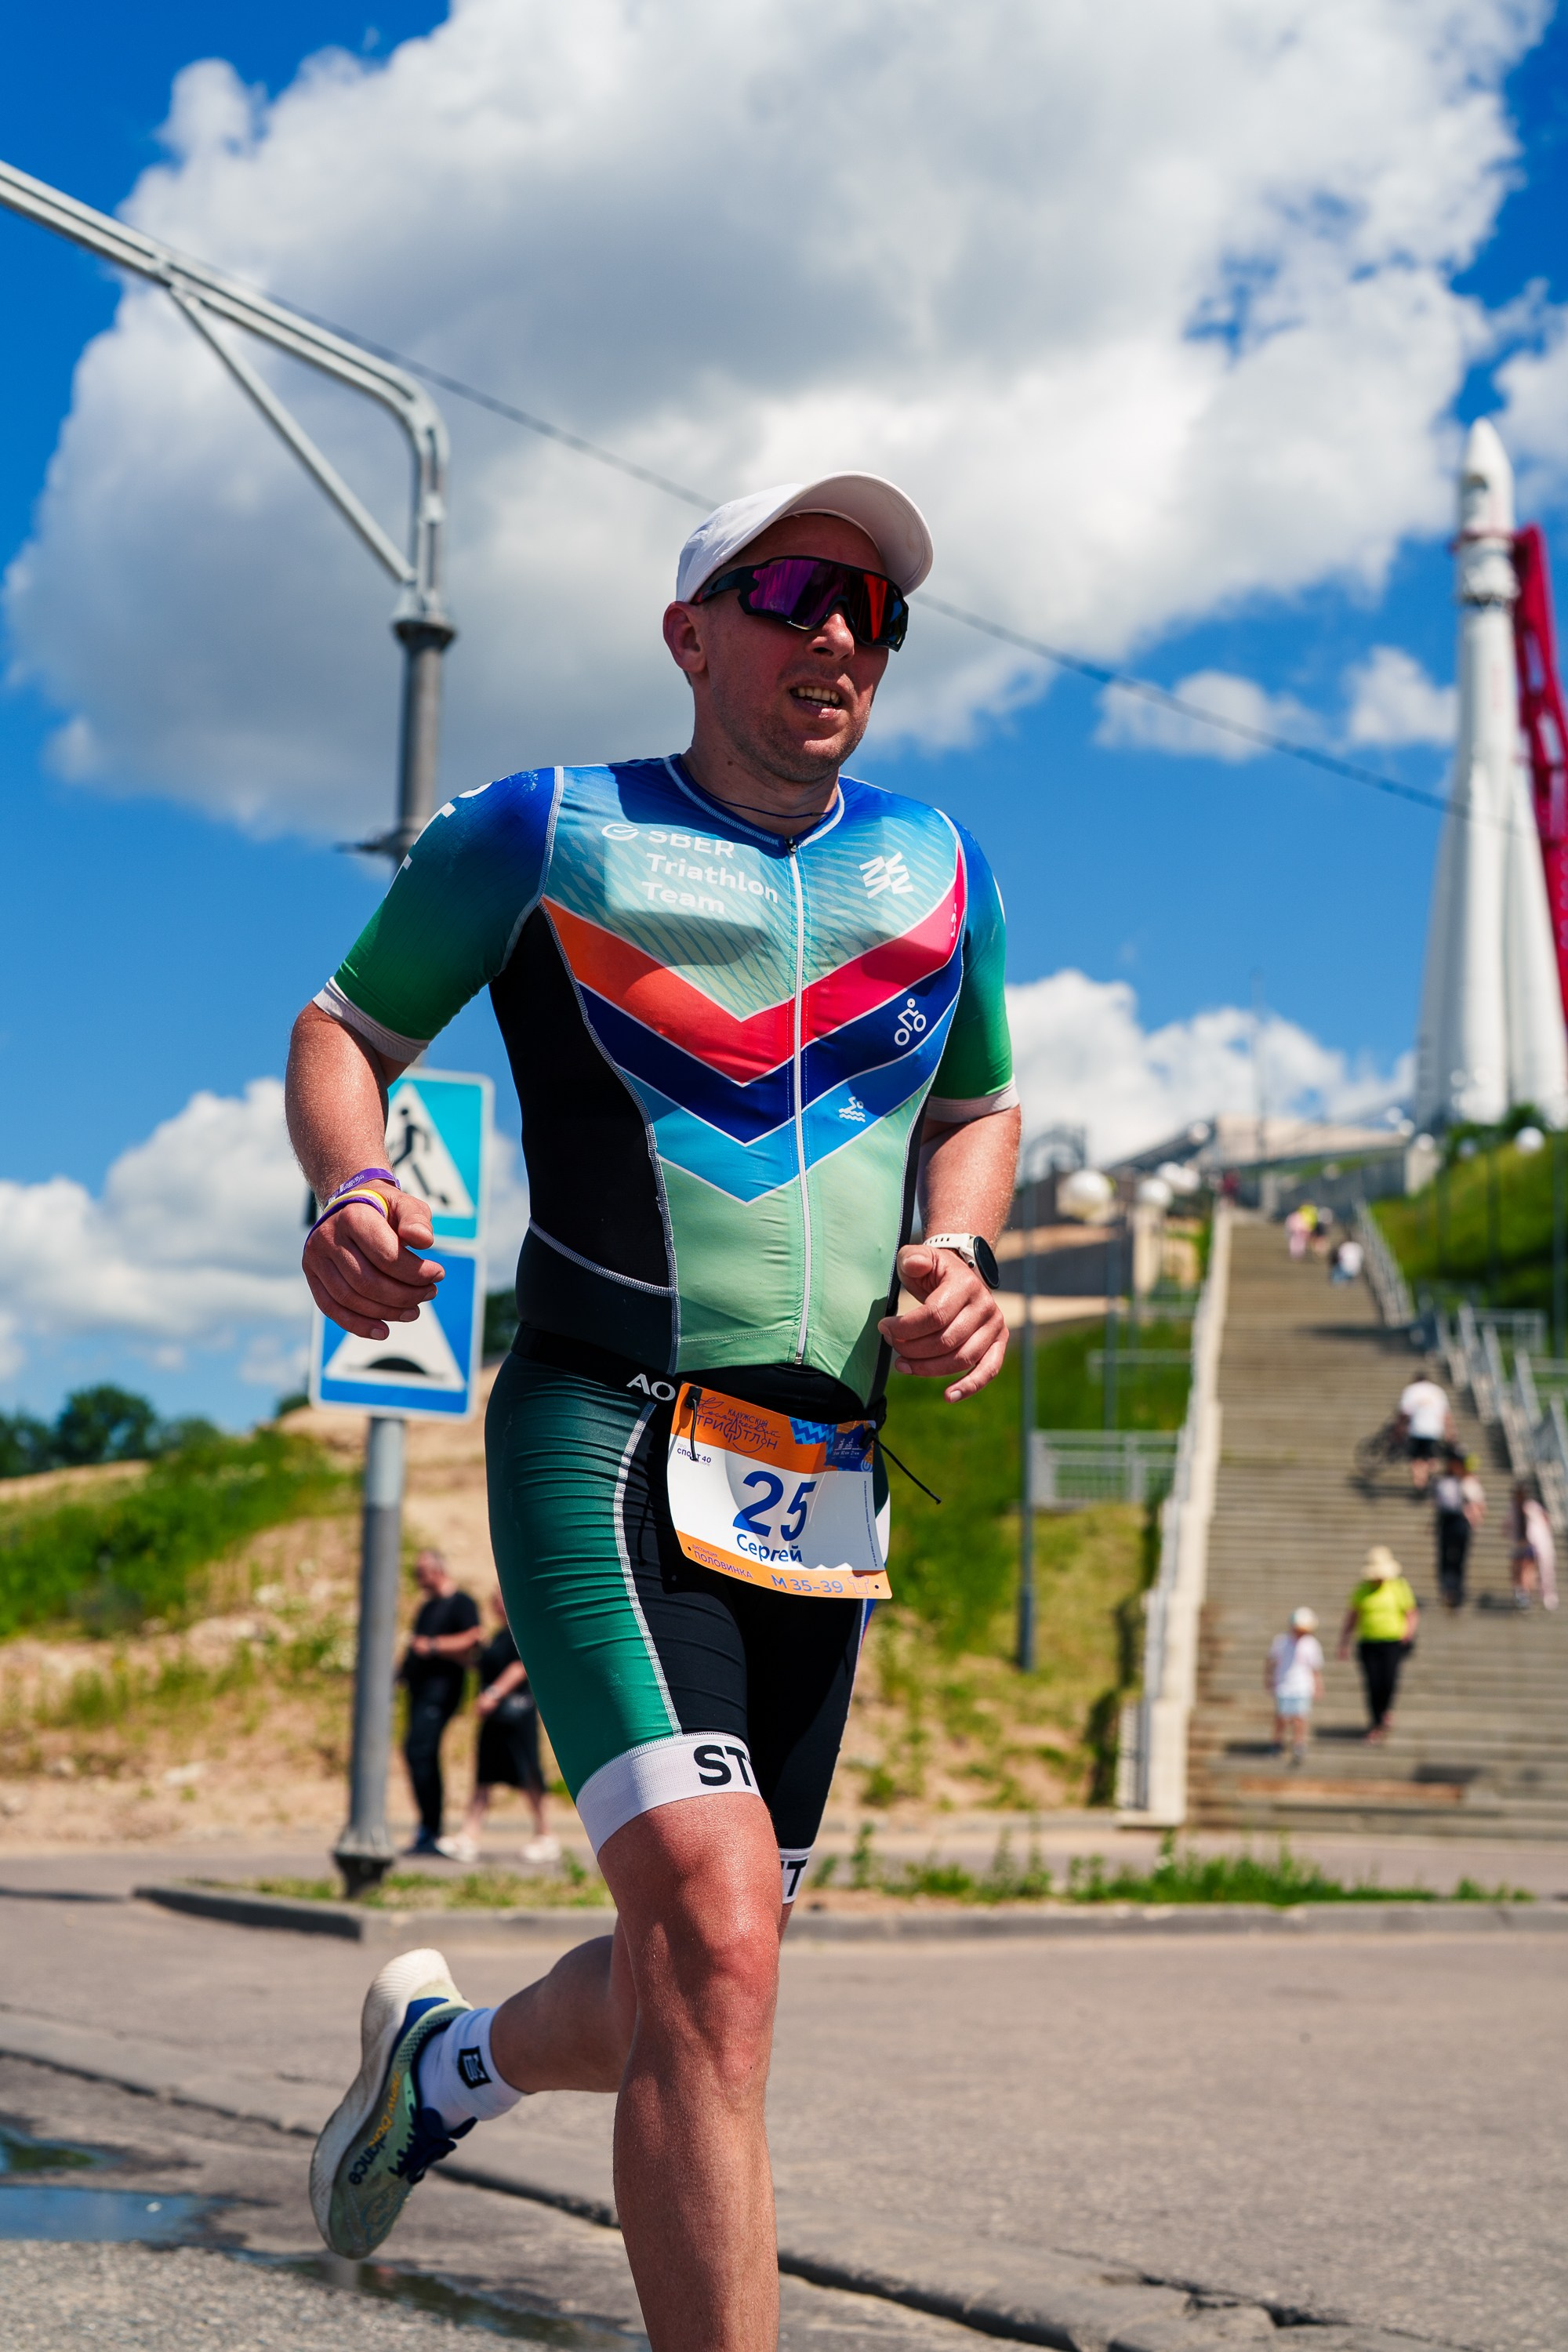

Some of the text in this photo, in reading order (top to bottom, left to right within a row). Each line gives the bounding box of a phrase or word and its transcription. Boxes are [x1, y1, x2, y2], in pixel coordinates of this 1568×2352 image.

[648, 830, 735, 859] SBER
[646, 852, 779, 904] Triathlon
[641, 880, 725, 914] Team
[677, 1447, 701, 1461] СПОТ
[733, 1471, 817, 1542] 25
[736, 1534, 803, 1563] Сергей
[694, 1550, 753, 1579] ПОЛОВИНКА
[789, 1578, 844, 1593] 35-39
